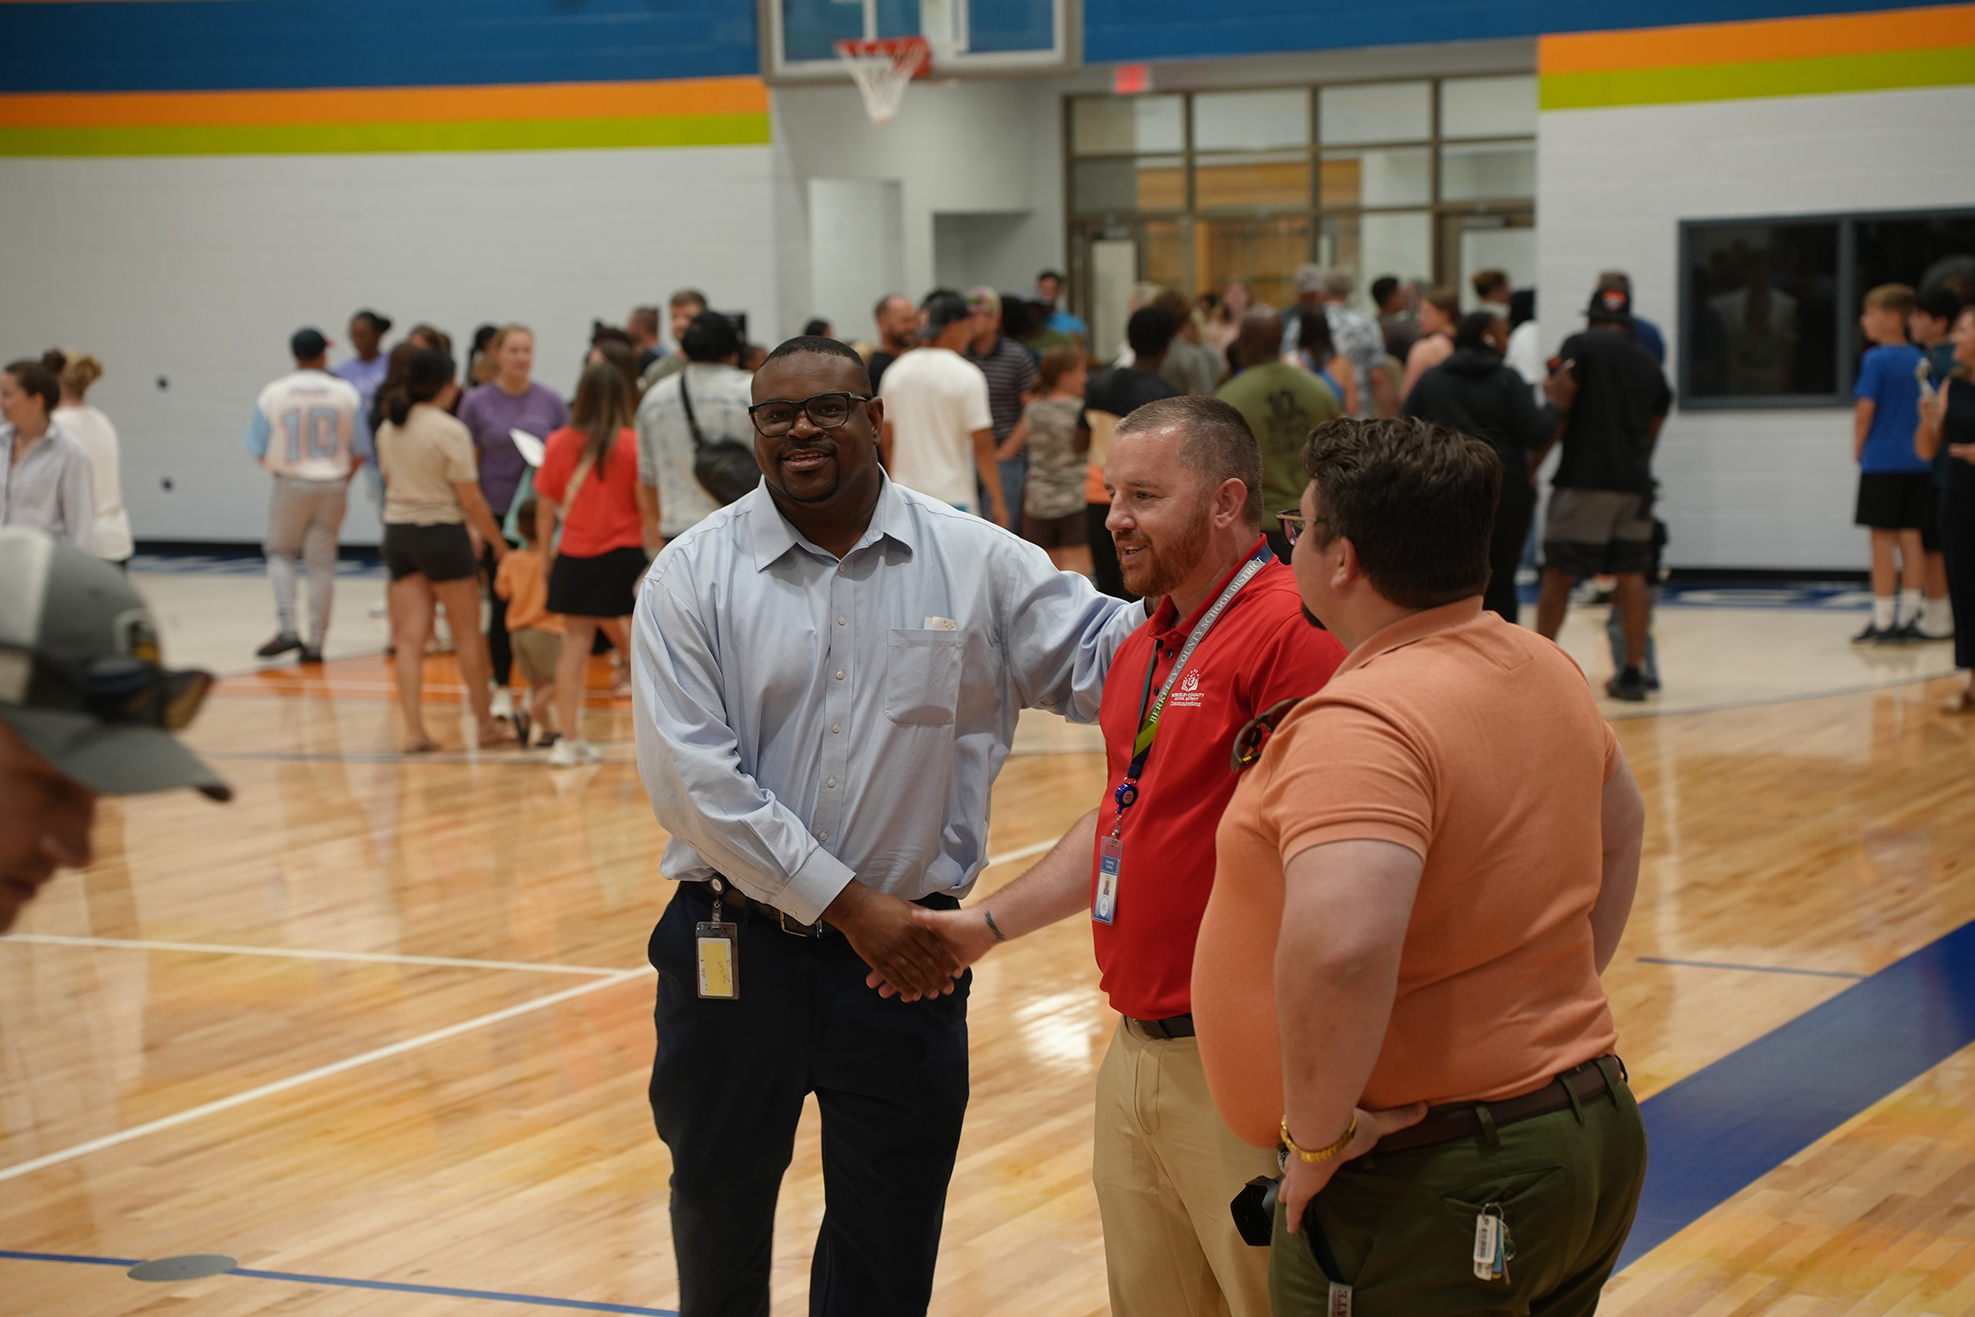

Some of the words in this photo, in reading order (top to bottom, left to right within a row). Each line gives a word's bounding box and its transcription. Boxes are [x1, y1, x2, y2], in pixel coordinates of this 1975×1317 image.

[281, 407, 340, 464] 10
[1149, 669, 1178, 723] BERKELEY
[1176, 628, 1203, 669] COUNTY
[1201, 593, 1233, 629] SCHOOL
[1230, 556, 1263, 593] DISTRICT
